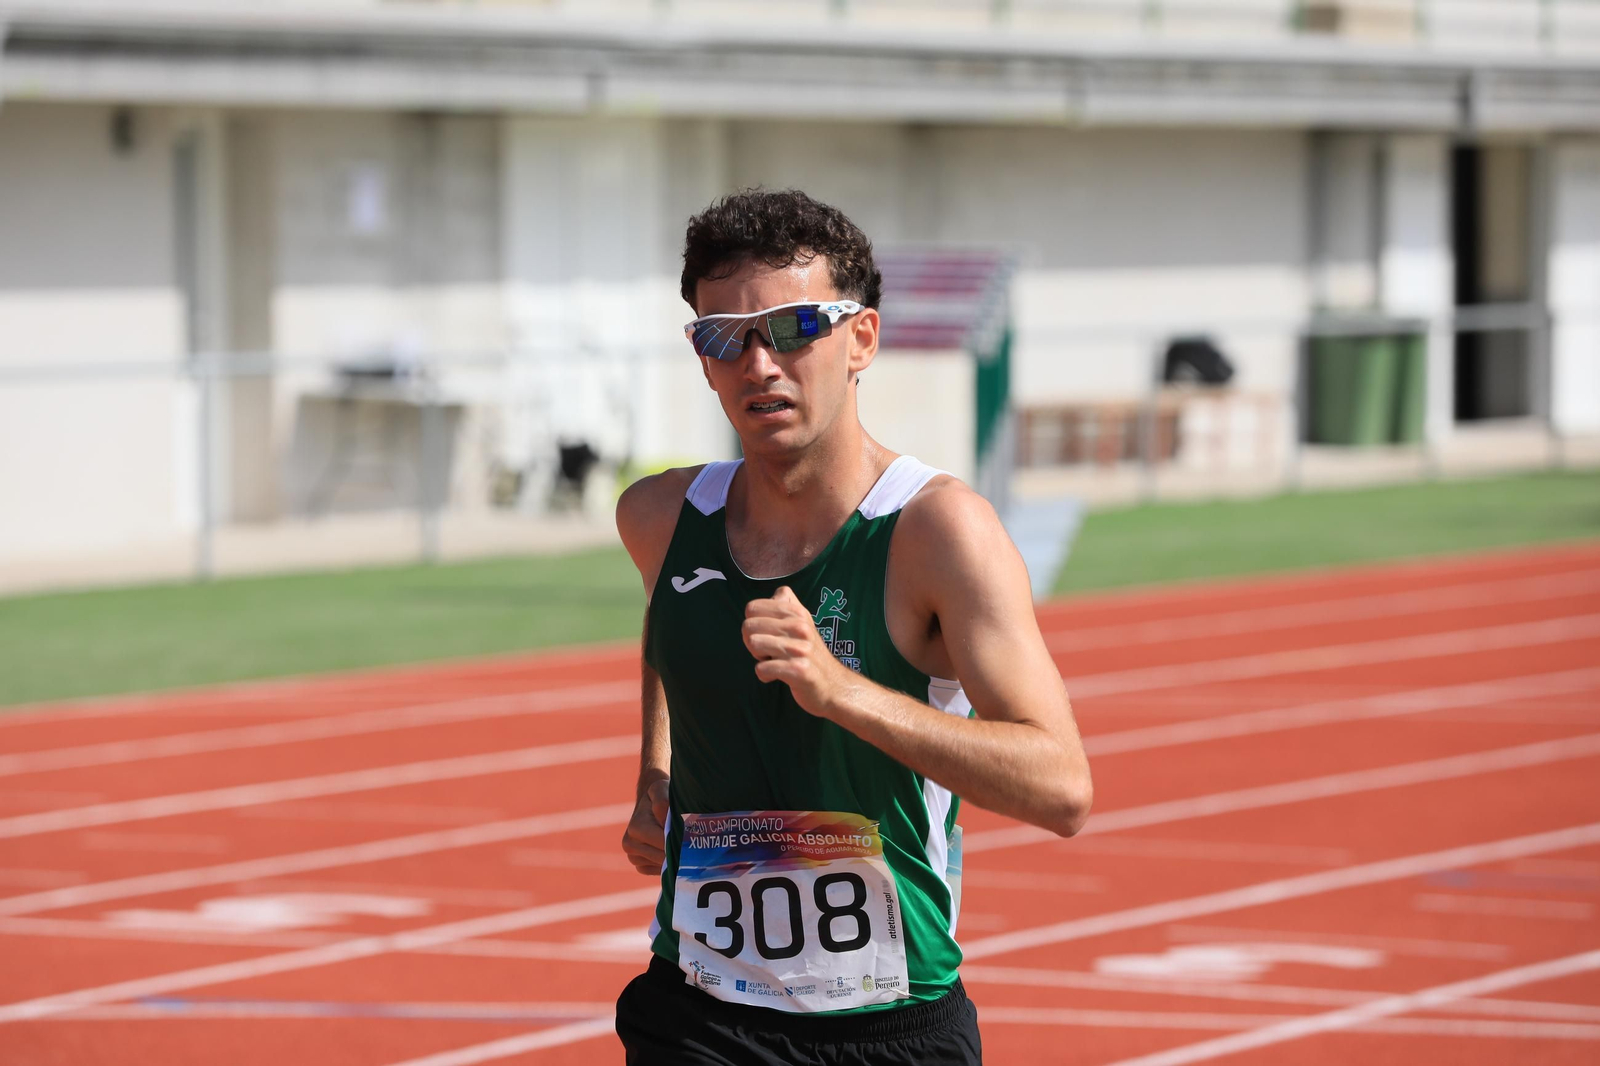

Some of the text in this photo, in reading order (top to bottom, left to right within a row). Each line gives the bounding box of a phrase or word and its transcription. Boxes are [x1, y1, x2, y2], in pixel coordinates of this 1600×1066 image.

[816, 627, 833, 642] ES
[824, 640, 855, 656] TISMO
[709, 817, 783, 833] CAMPIONATO
[688, 832, 873, 849] XUNTA DE GALICIA ABSOLUTO
[814, 847, 825, 855] DE
[694, 871, 872, 960] 308
[882, 891, 898, 940] atletismo.gal
[748, 981, 771, 990] XUNTA
[757, 989, 784, 997] GALICIA
[796, 984, 817, 992] DEPORTE
